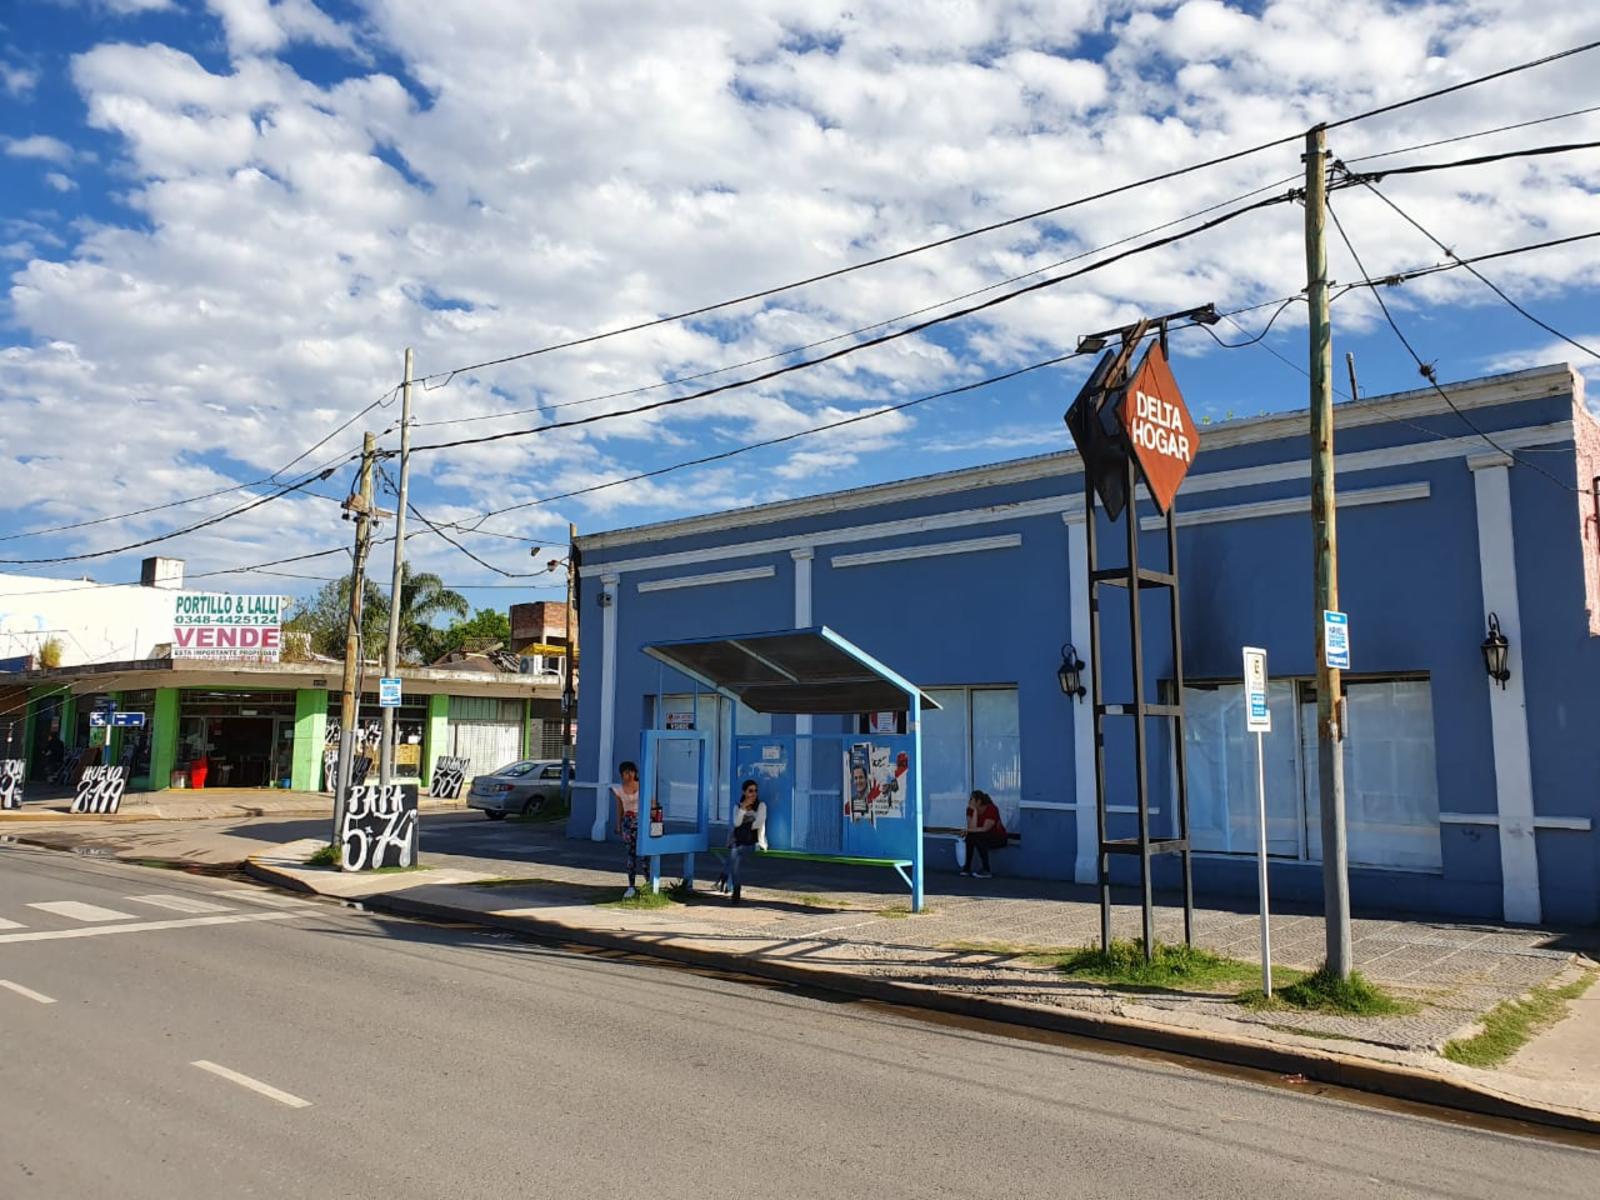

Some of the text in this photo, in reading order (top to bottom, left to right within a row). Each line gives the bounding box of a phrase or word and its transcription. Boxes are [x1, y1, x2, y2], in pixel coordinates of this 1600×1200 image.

[1135, 390, 1184, 433] DELTA
[1131, 416, 1190, 463] HOGAR
[176, 596, 279, 614] PORTILLO & LALLI
[175, 615, 278, 624] 0348-4425124
[174, 627, 279, 647] VENDE
[348, 784, 406, 813] PAPA
